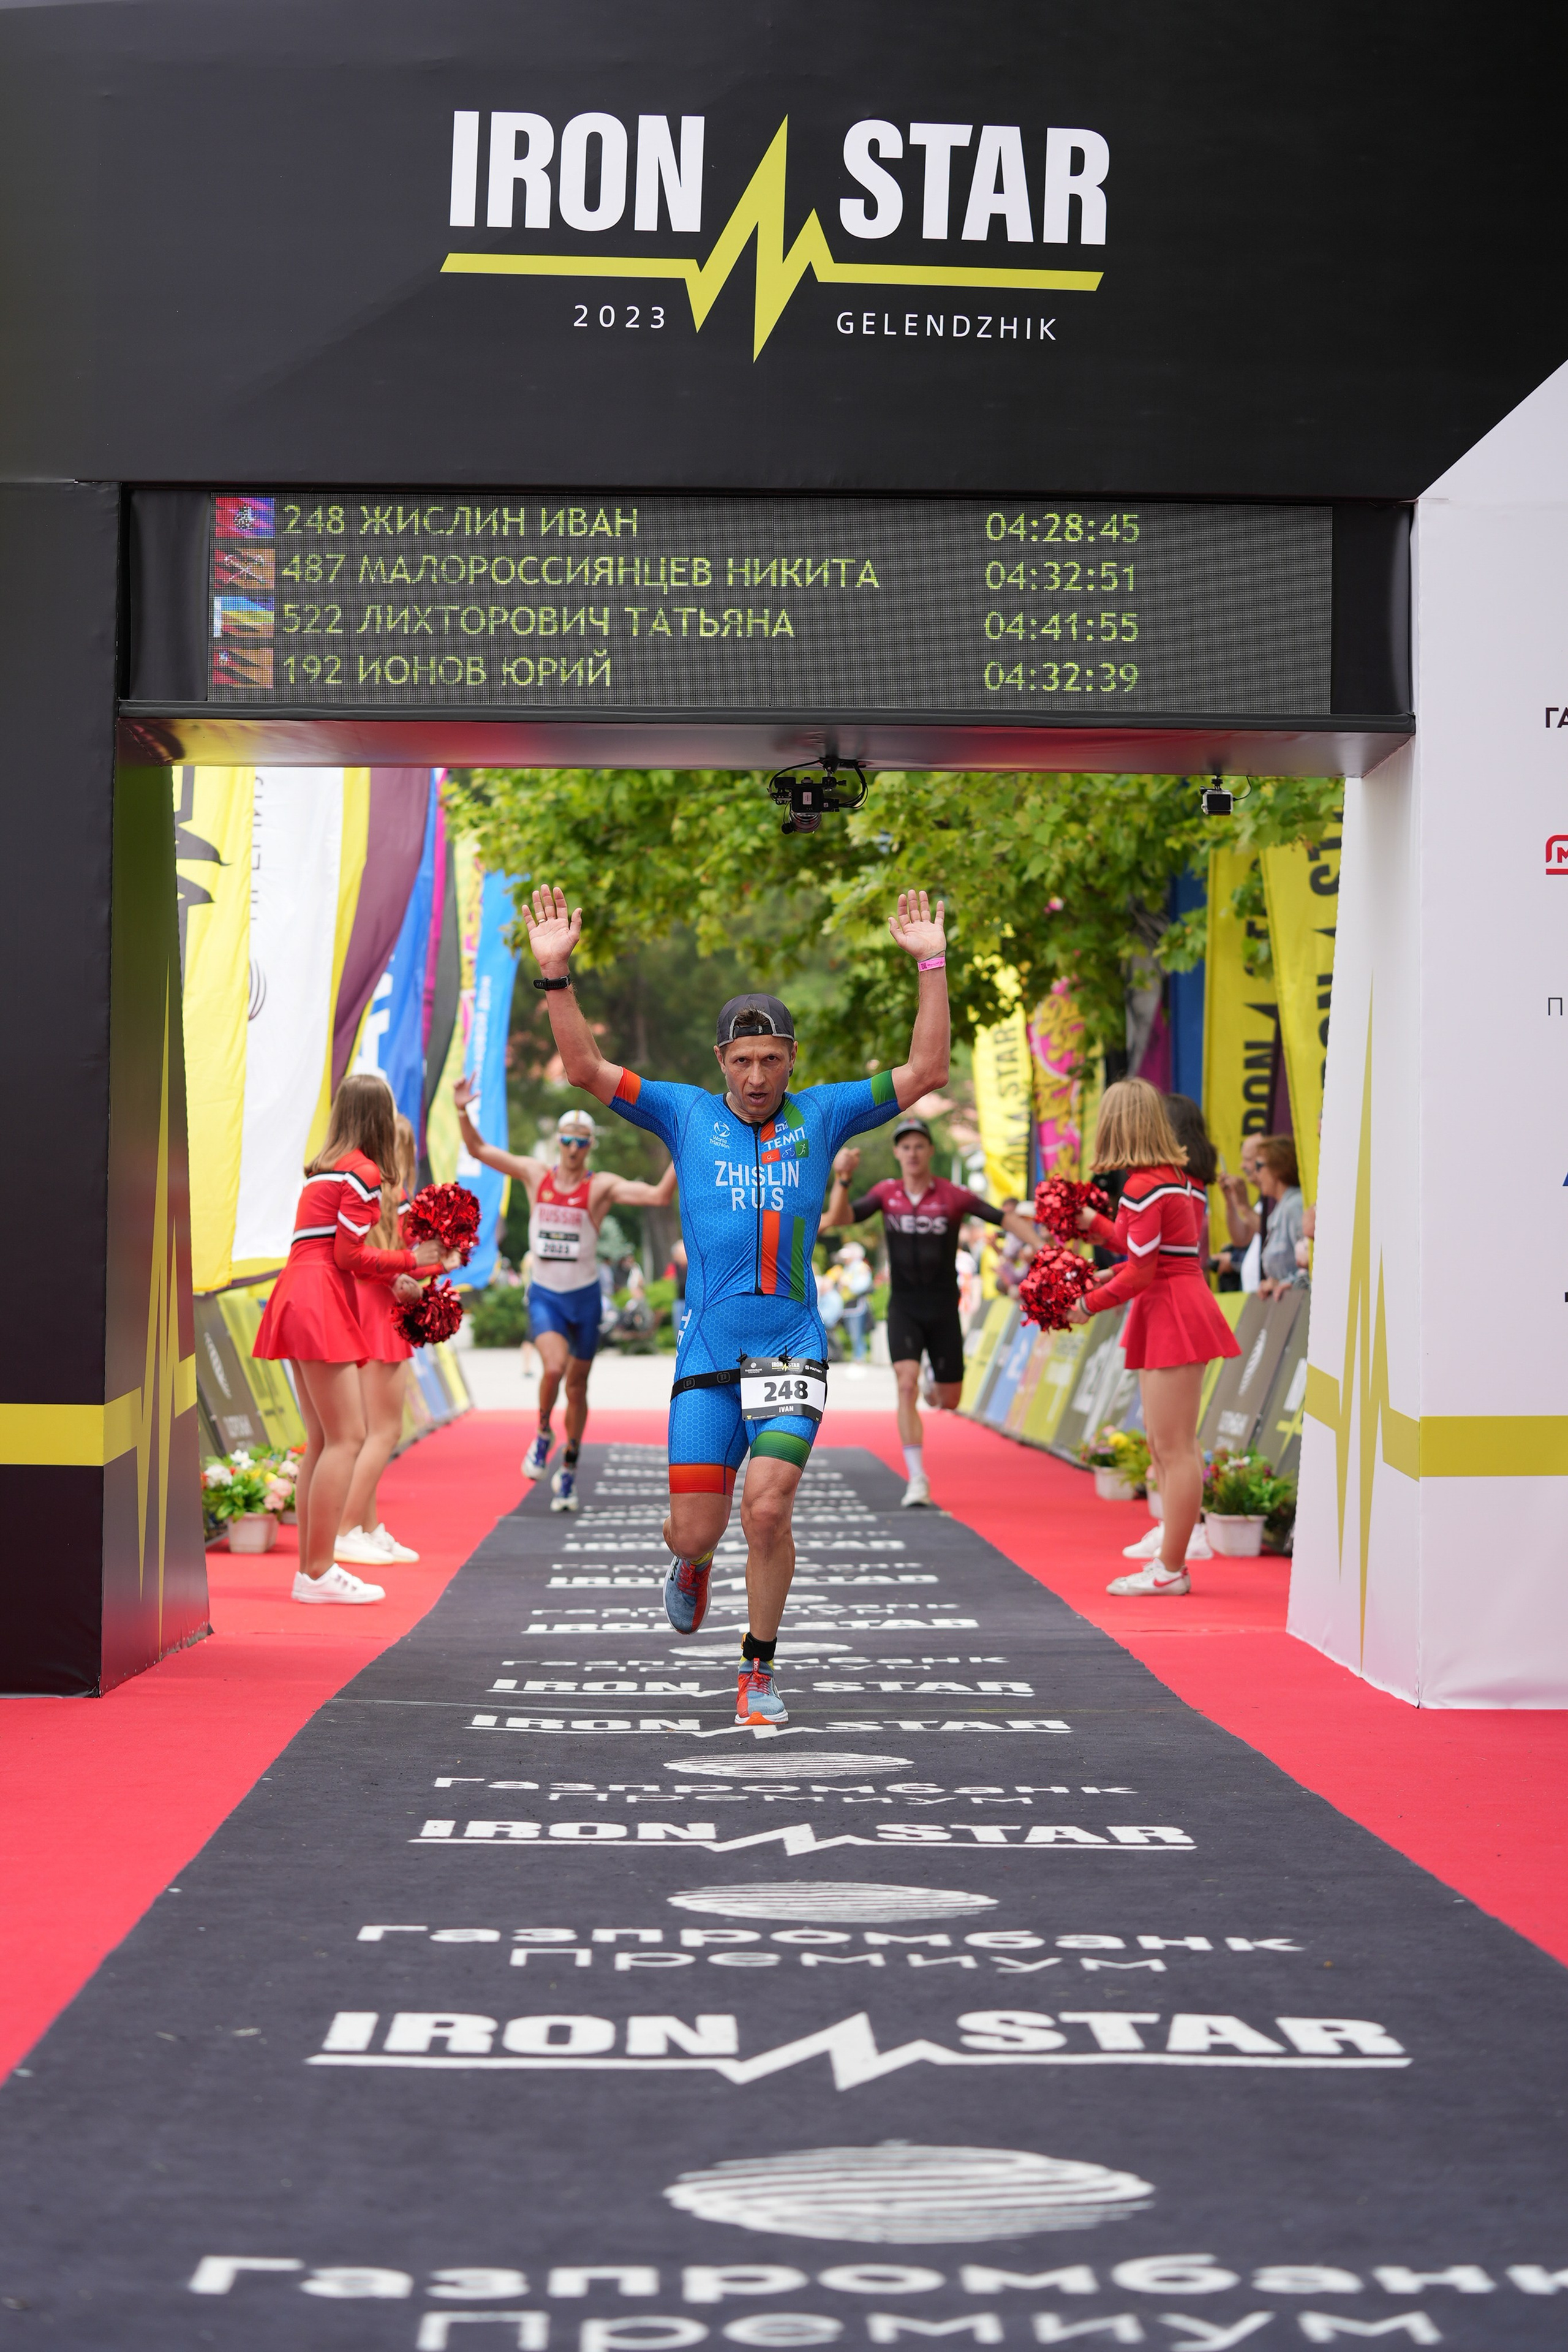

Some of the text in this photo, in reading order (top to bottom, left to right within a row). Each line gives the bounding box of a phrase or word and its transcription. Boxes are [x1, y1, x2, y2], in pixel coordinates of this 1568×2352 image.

[450, 111, 1109, 244] IRON STAR
[574, 305, 1056, 341] 2023 GELENDZHIK
[282, 505, 1140, 543] 248 ЖИСЛИН ИВАН 04:28:45
[282, 554, 1136, 595] 487 МАЛОРОССИЯНЦЕВ НИКИТА 04:32:51
[282, 604, 1139, 641] 522 ЛИХТОРОВИЧ ТАТЬЯНА 04:41:55
[282, 649, 1139, 692] 192 ИОНОВ ЮРИЙ 04:32:39
[709, 1138, 730, 1149] Triathlon
[713, 1134, 727, 1144] World
[714, 1160, 799, 1188] ZHISLIN
[731, 1187, 784, 1212] RUS
[764, 1380, 809, 1403] 248
[492, 1679, 1035, 1692] IRON STAR
[471, 1714, 1072, 1731] IRON STAR
[433, 1777, 1139, 1794] Газпромбанк
[547, 1792, 1034, 1806] Премиум
[420, 1820, 1195, 1844] IRON STAR
[356, 1925, 1305, 1951] Газпромбанк
[510, 1948, 1169, 1973] Премиум
[322, 2010, 1405, 2055] IRON STAR
[417, 2311, 1441, 2352] Премиум
